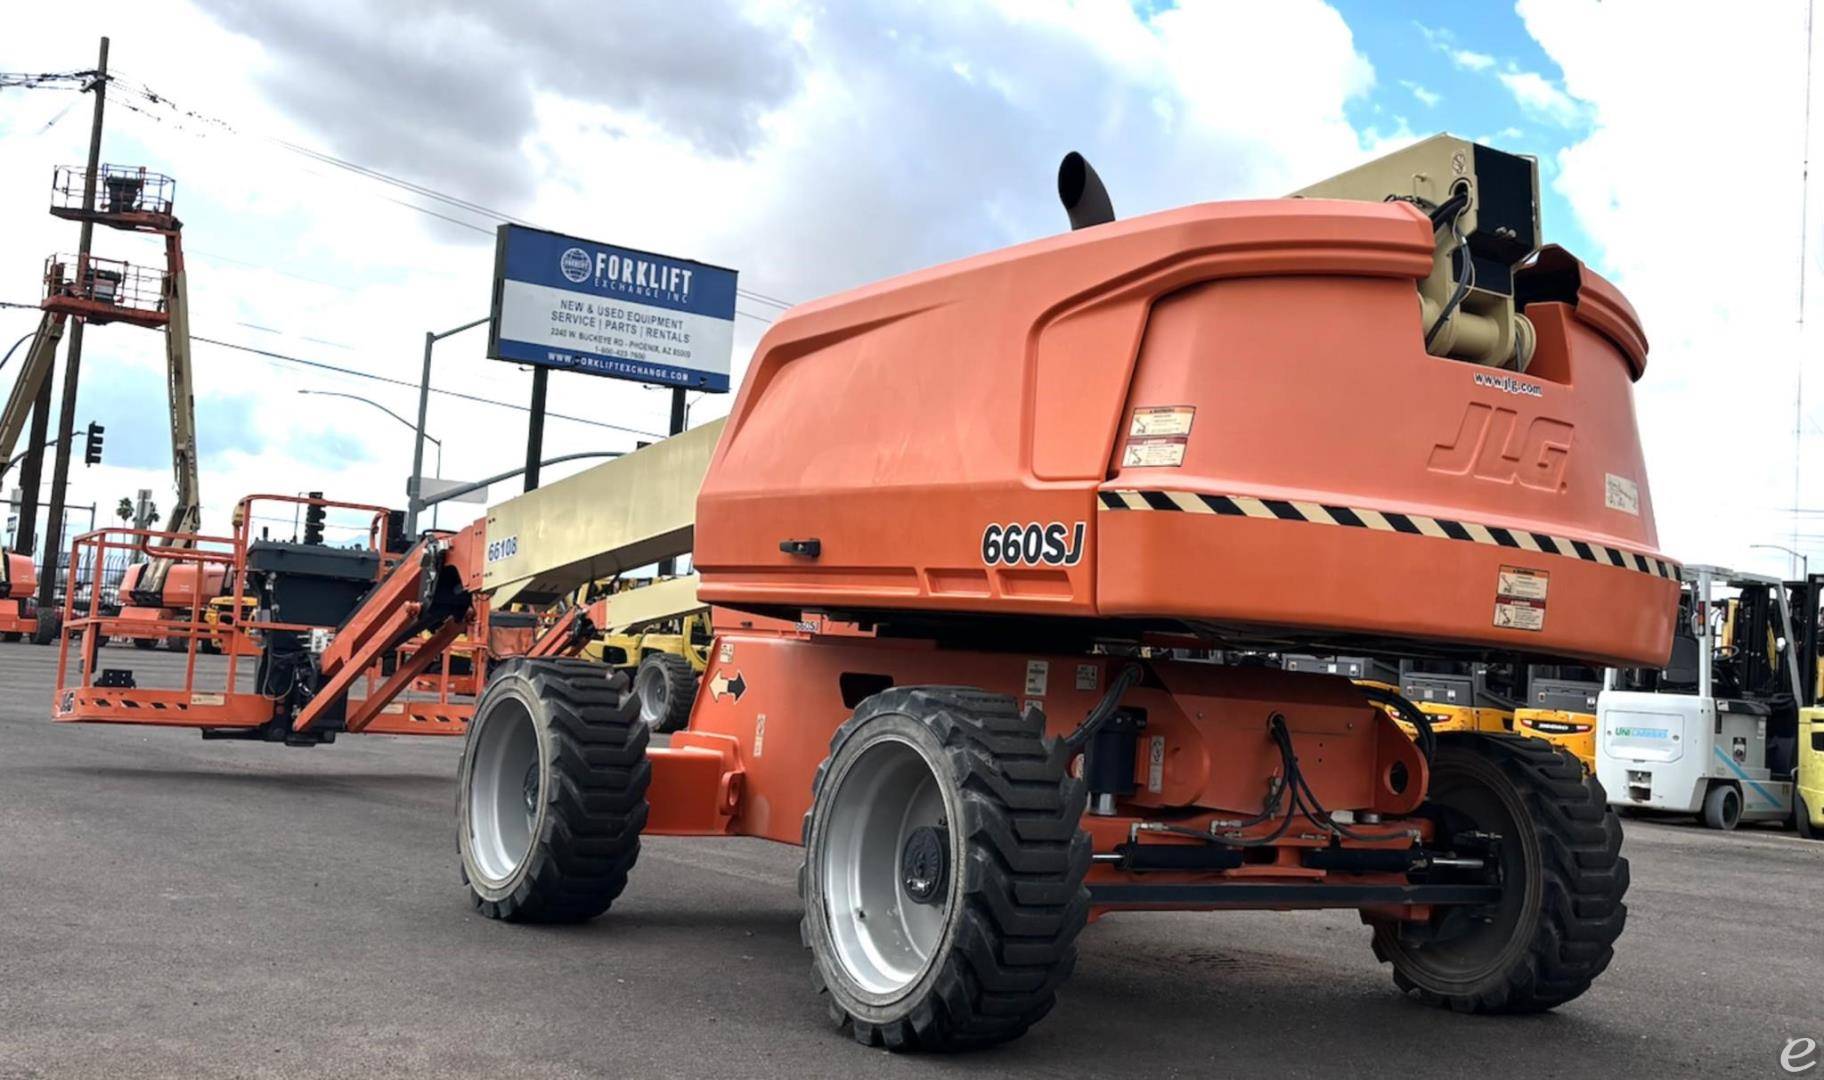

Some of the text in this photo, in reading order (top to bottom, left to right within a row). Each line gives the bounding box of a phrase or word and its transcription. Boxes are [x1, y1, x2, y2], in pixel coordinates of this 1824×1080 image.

[595, 252, 692, 294] FORKLIFT
[594, 278, 688, 304] EXCHANGE INC
[551, 310, 595, 328] SERVICE
[604, 319, 637, 335] PARTS
[646, 327, 691, 344] RENTALS
[560, 299, 684, 330] NEW & USED EQUIPMENT
[1474, 372, 1542, 396] www.jlg.com
[1426, 401, 1575, 493] JLG
[488, 536, 518, 562] 66108
[982, 522, 1086, 566] 660SJ
